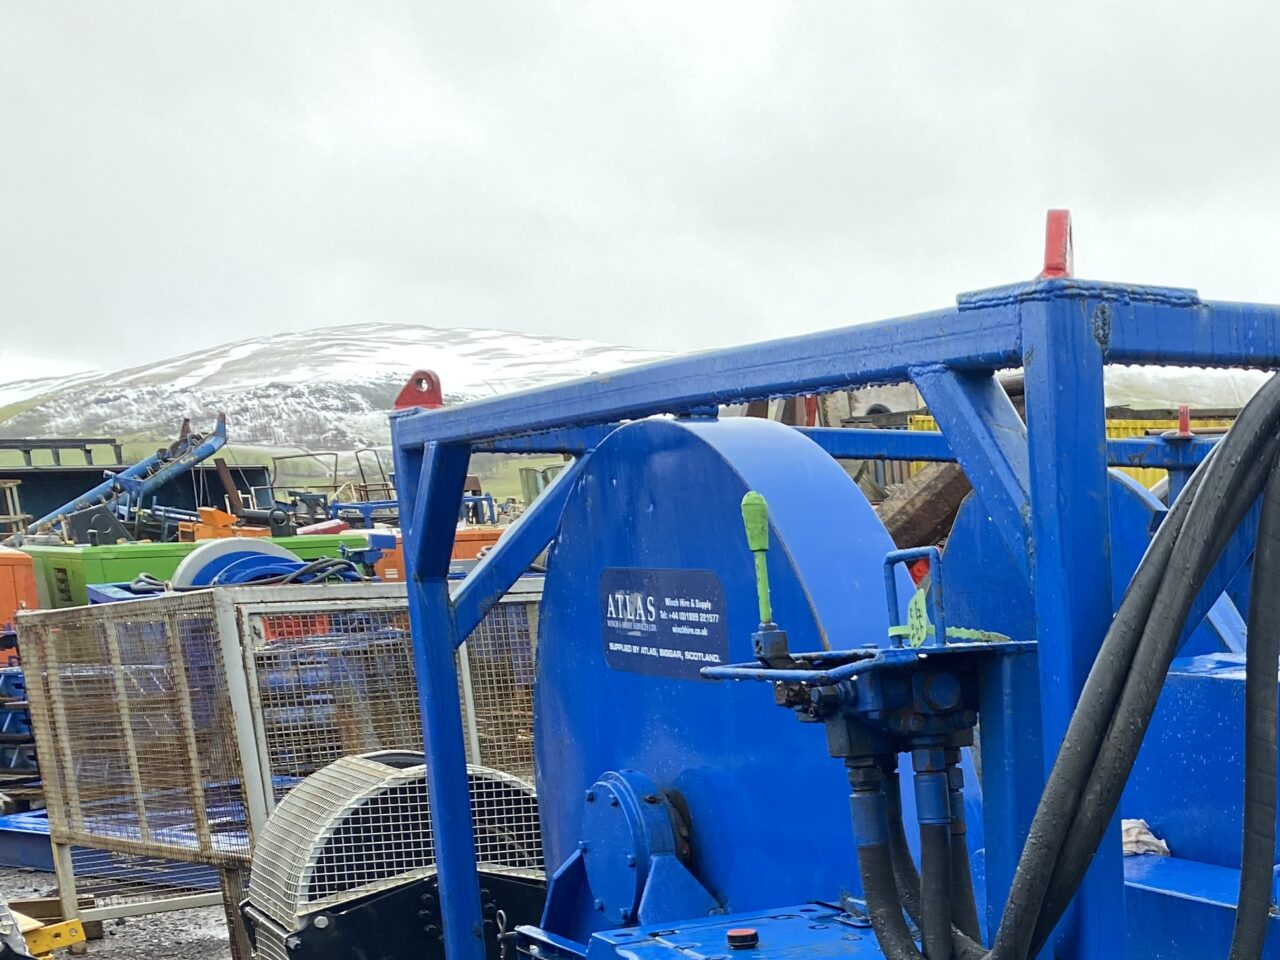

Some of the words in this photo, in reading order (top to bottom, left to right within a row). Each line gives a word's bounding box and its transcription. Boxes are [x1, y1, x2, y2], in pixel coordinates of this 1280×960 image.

[606, 594, 656, 622] ATLAS
[664, 598, 678, 606] Winch
[679, 598, 690, 608] Hire
[690, 598, 695, 608] &
[695, 599, 712, 610] Supply
[668, 611, 678, 620] +44
[700, 613, 719, 623] 221577
[672, 624, 708, 636] winchhire.co.uk
[609, 642, 632, 652] SUPPLIED
[632, 646, 640, 654] BY
[640, 646, 659, 658] ATLAS,
[659, 648, 683, 661] BIGGAR,
[685, 651, 721, 662] SCOTLAND.
